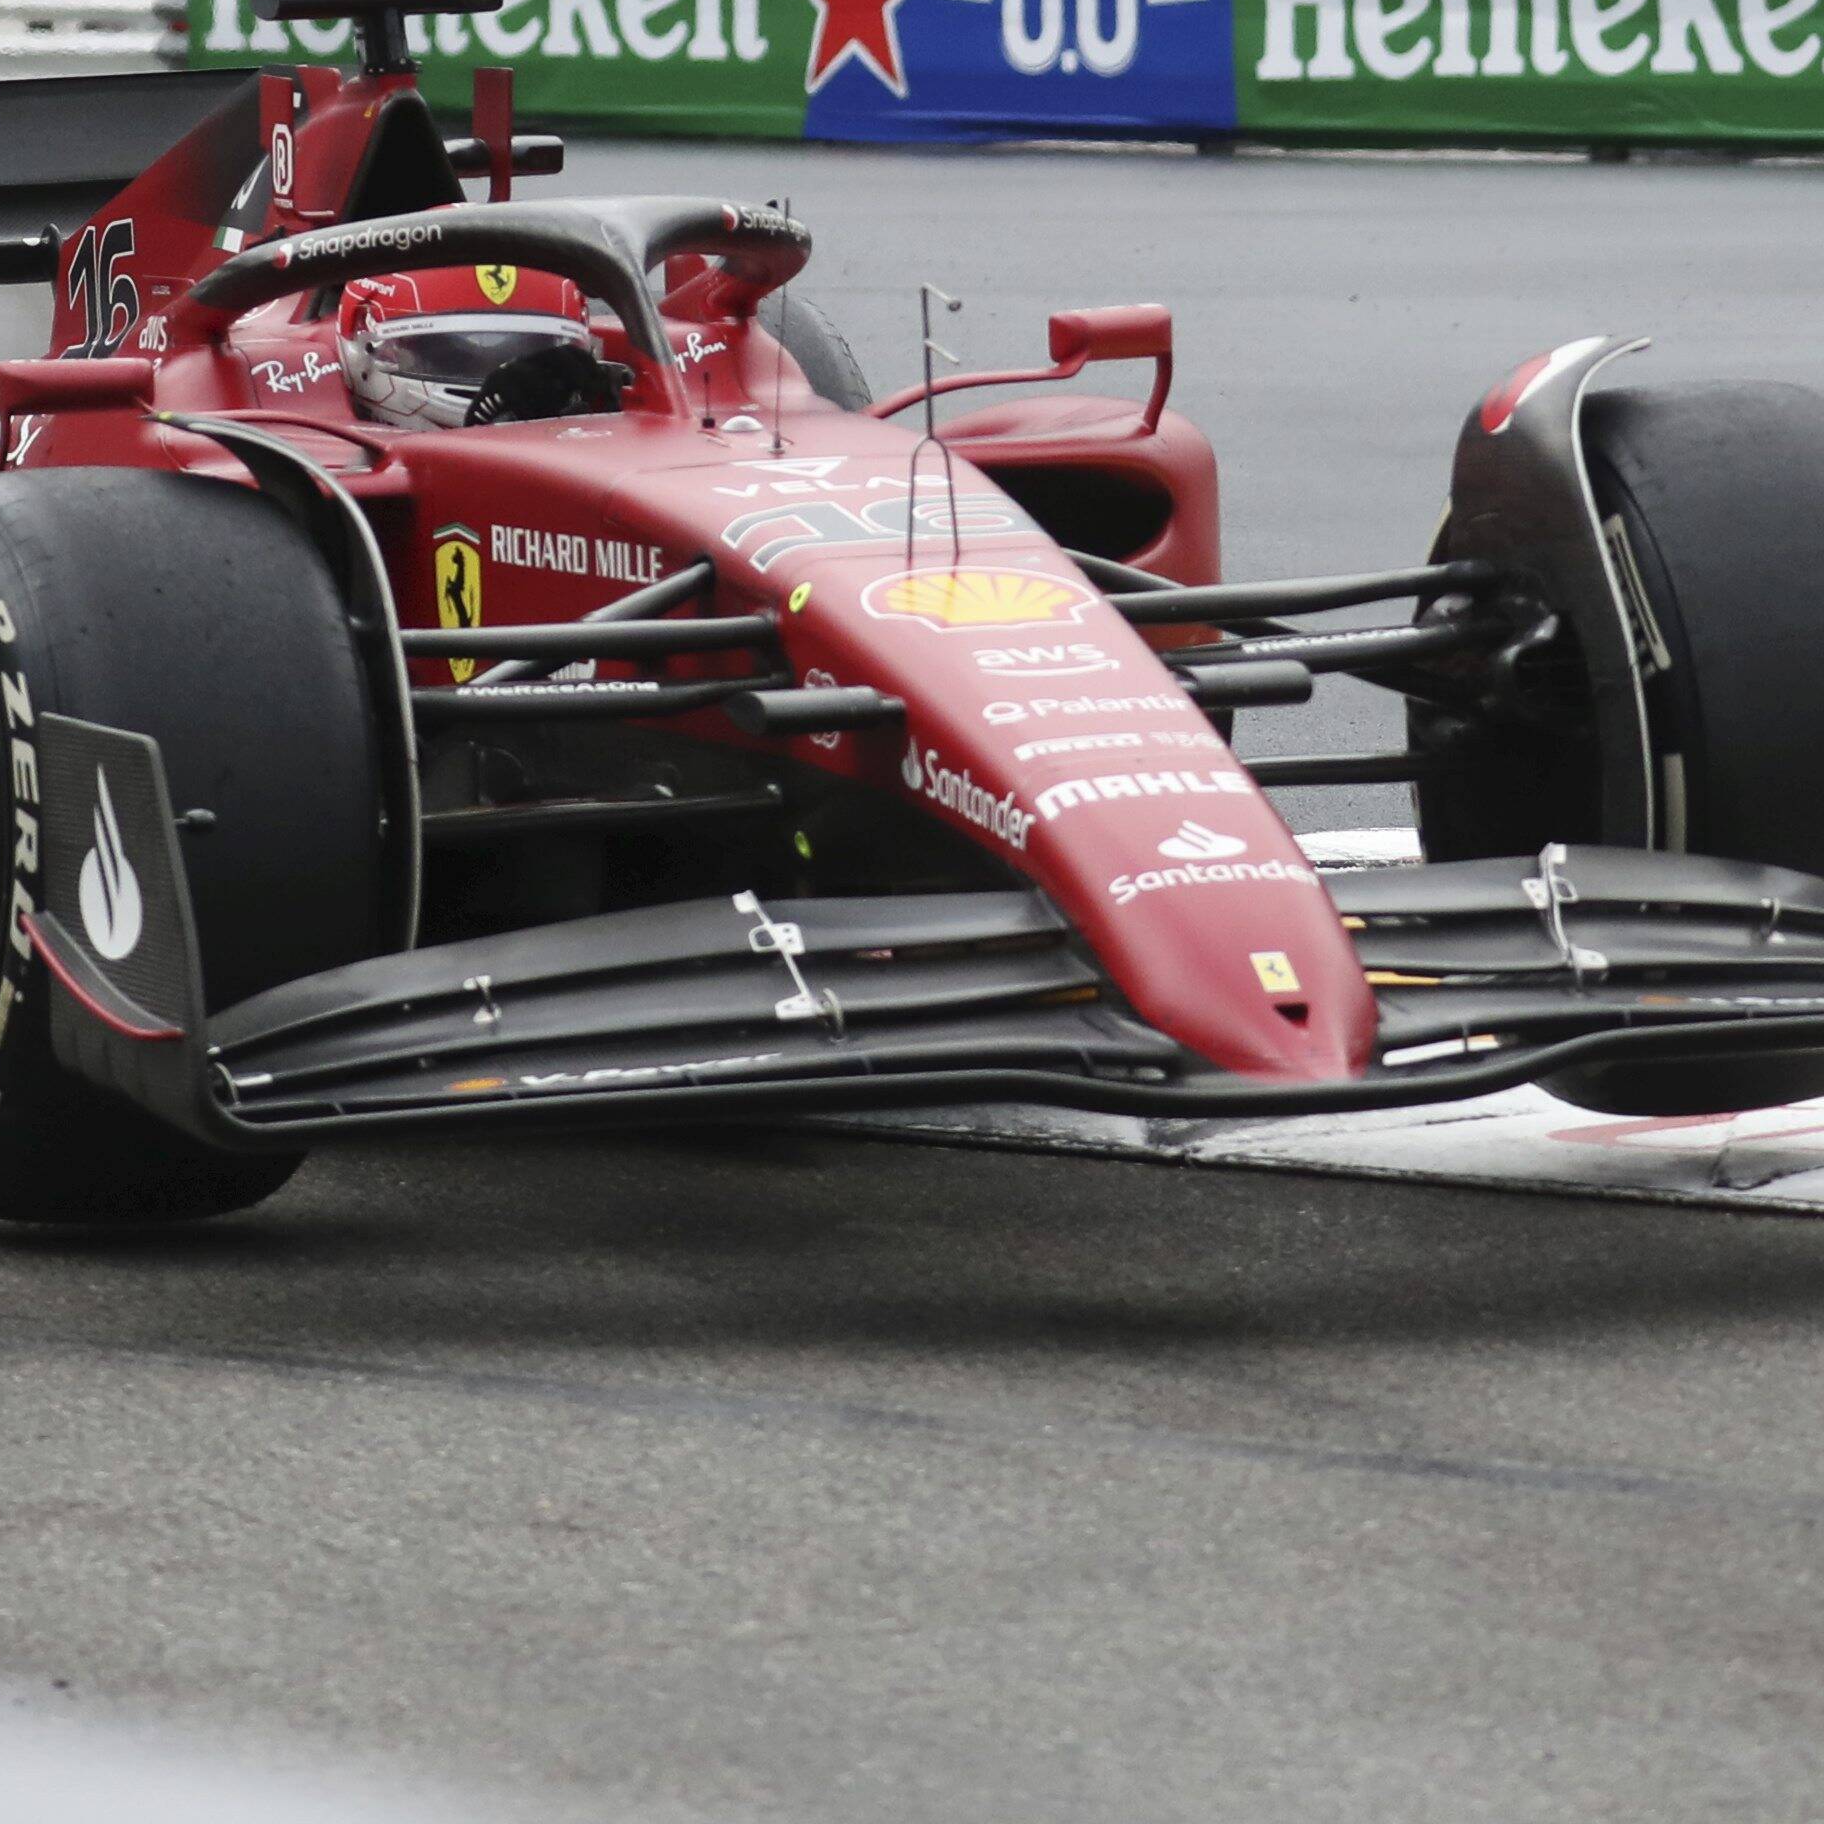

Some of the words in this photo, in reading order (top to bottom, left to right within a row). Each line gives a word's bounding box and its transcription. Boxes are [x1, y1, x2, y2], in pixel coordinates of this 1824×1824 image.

[298, 224, 442, 260] Snapdragon
[68, 218, 139, 359] 16
[672, 332, 726, 373] y-Ban
[491, 524, 588, 575] RICHARD
[595, 539, 663, 584] MILLE
[721, 493, 1042, 573] 16
[972, 643, 1105, 667] aws
[1, 671, 40, 960] ZERO
[926, 748, 1037, 850] Santander
[1035, 770, 1252, 821] MAHLE
